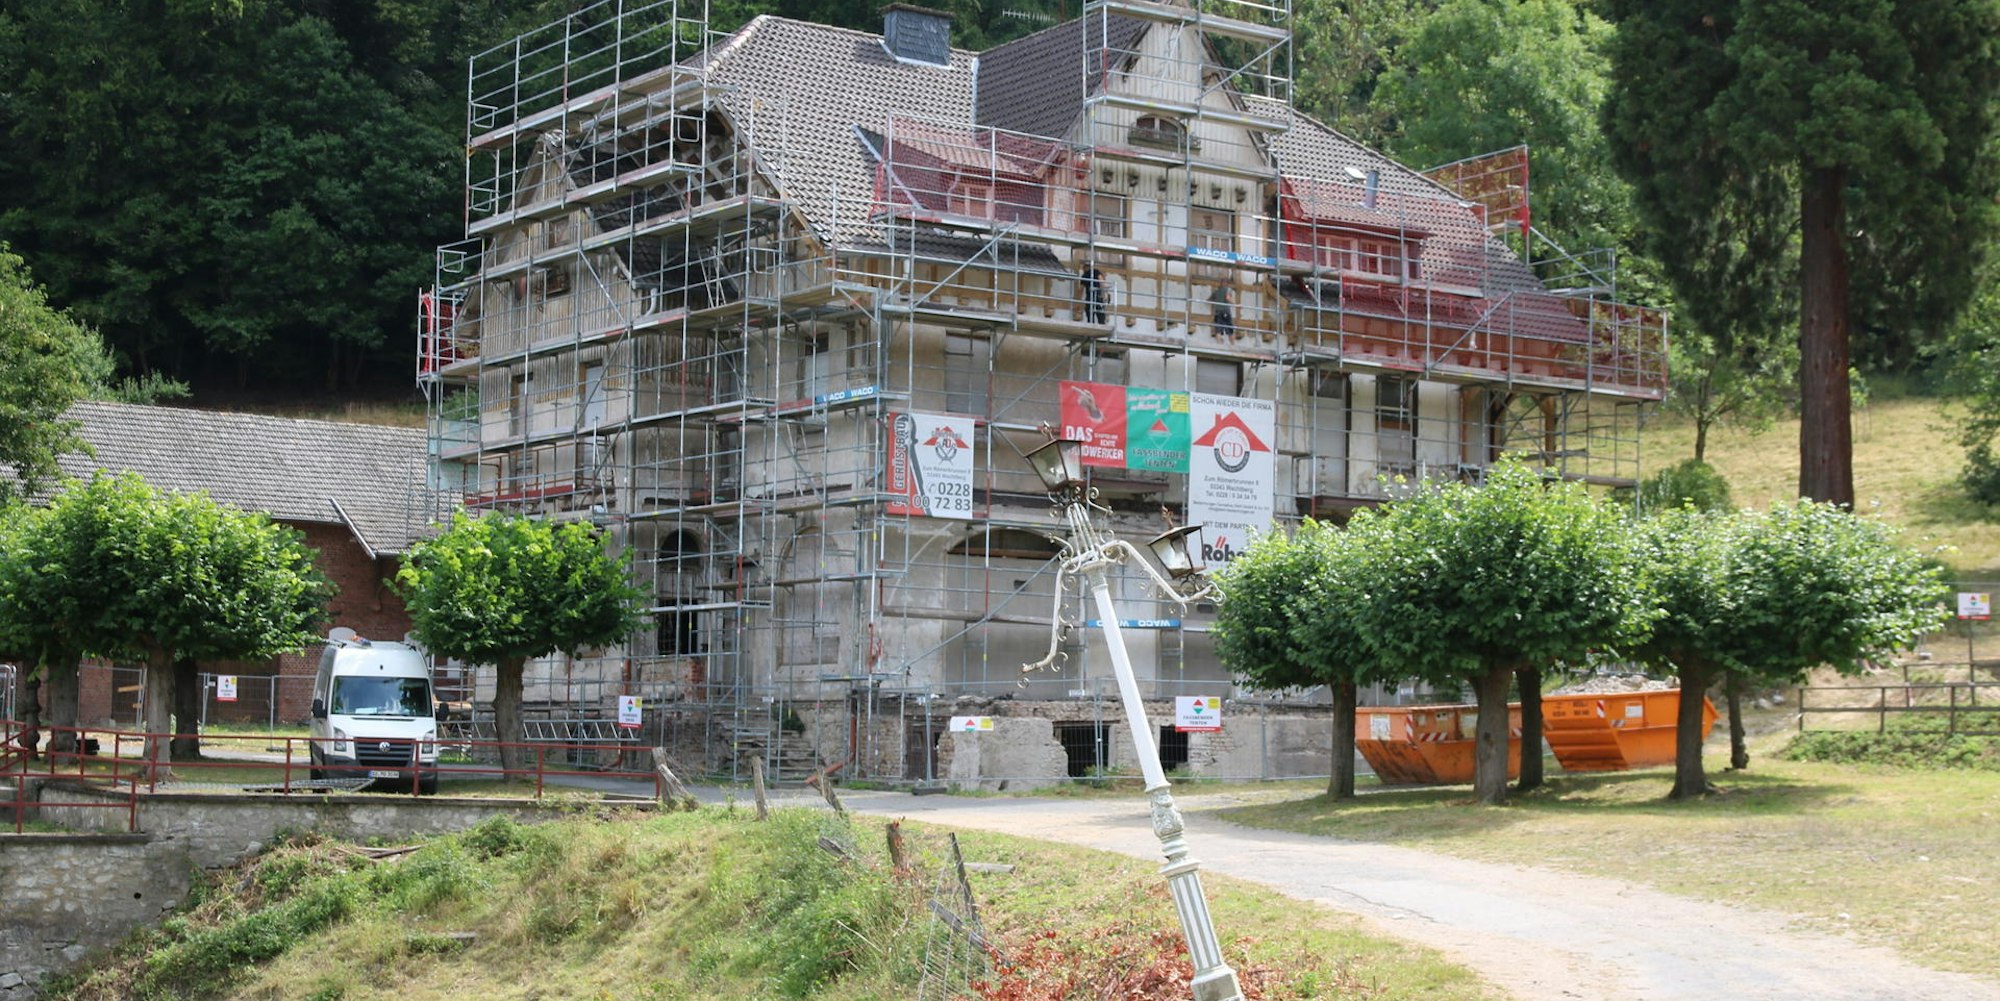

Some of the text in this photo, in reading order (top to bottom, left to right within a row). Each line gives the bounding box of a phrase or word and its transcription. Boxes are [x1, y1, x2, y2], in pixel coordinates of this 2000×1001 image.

[1196, 248, 1267, 264] WACO WACO
[851, 386, 874, 396] WACO
[1193, 396, 1215, 405] SCHON
[1216, 399, 1240, 408] WIEDER
[1242, 401, 1252, 409] DIE
[1253, 403, 1272, 411] FIRMA
[1066, 425, 1093, 442] DAS
[1068, 445, 1124, 460] ANDWERKER
[1132, 447, 1186, 459] FASSBENDER
[1221, 441, 1244, 458] CD
[938, 482, 970, 497] 0228
[913, 495, 930, 508] 00
[935, 497, 951, 509] 72
[955, 498, 971, 511] 83
[1230, 522, 1258, 530] PARTNR
[1137, 619, 1171, 627] WACO
